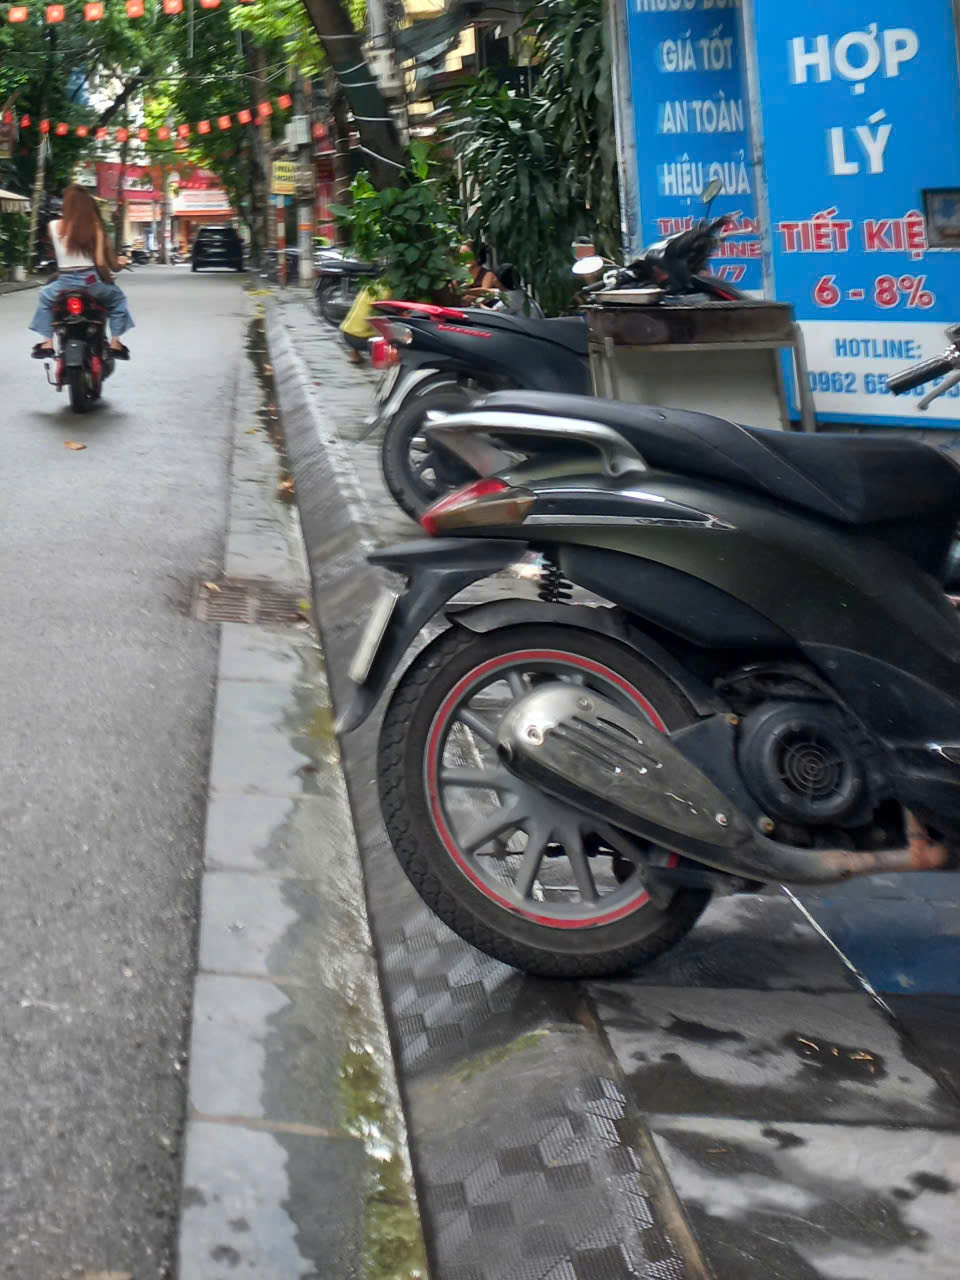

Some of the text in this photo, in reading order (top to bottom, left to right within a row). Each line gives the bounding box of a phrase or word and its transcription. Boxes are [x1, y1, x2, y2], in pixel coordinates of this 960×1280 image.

[661, 23, 733, 72] GIÁ TỐT
[790, 22, 919, 95] HỢP
[661, 90, 745, 134] AN TOÀN
[828, 108, 893, 176] LÝ
[662, 152, 703, 205] HIỆU
[779, 206, 928, 260] TIẾT KIỆ
[814, 274, 841, 308] 6
[873, 274, 935, 309] 8%
[834, 338, 923, 359] HOTLINE:
